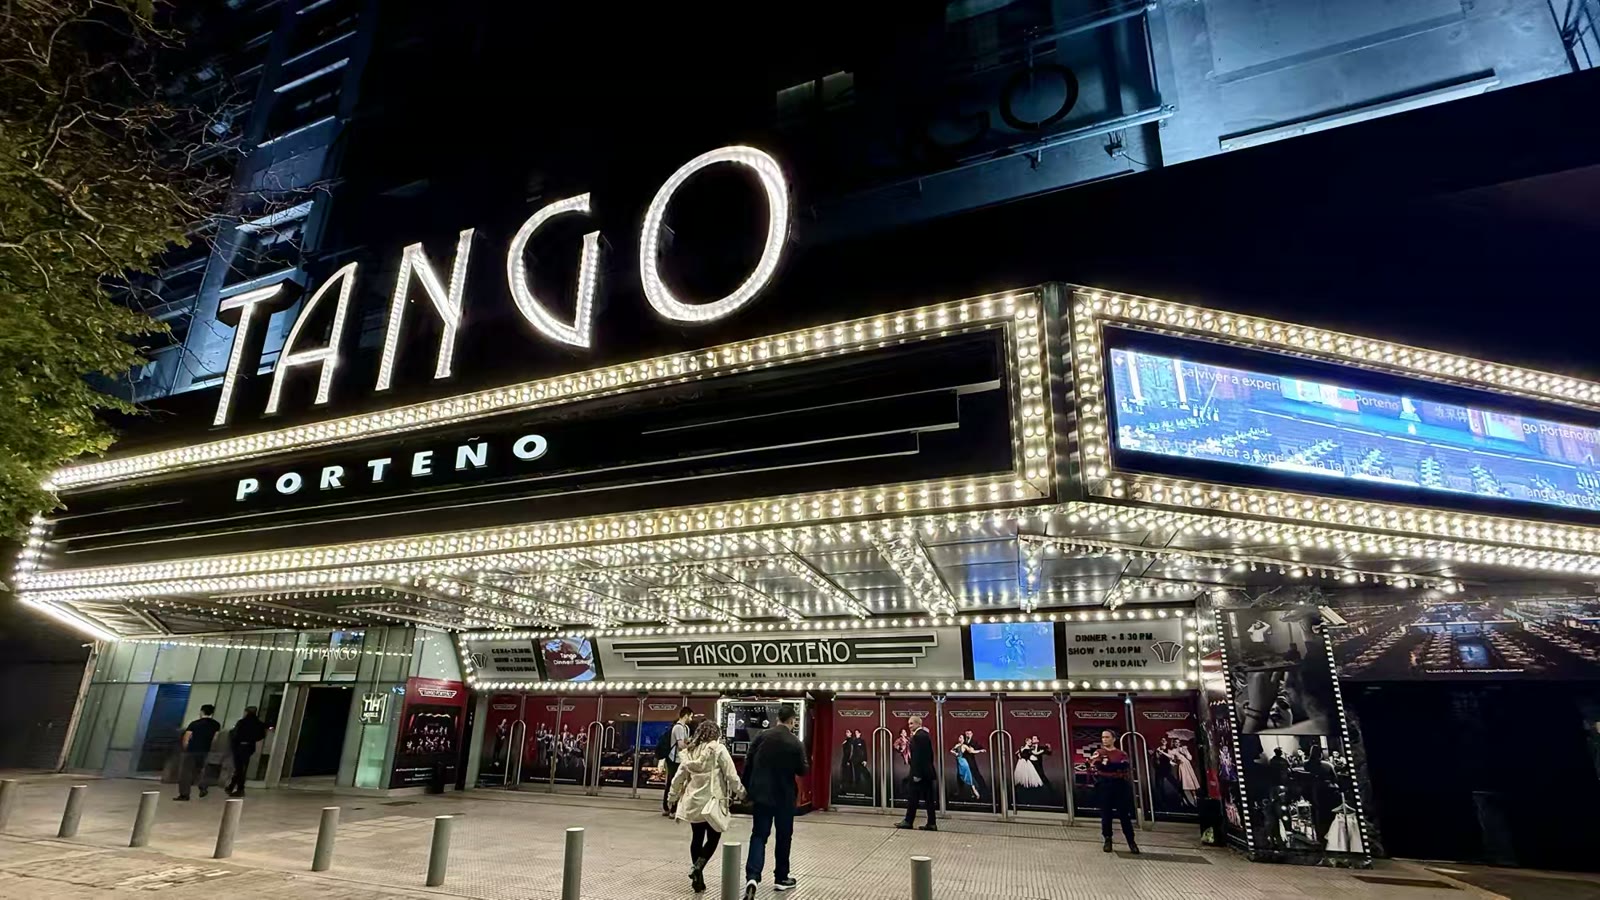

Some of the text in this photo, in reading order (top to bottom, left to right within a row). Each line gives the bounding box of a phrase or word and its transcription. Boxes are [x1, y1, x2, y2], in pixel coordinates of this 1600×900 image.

[213, 145, 789, 426] TANGO
[235, 434, 547, 501] PORTEÑO
[680, 638, 850, 664] TANGO PORTEÑO
[1068, 647, 1094, 655] SHOW
[1075, 634, 1107, 642] DINNER
